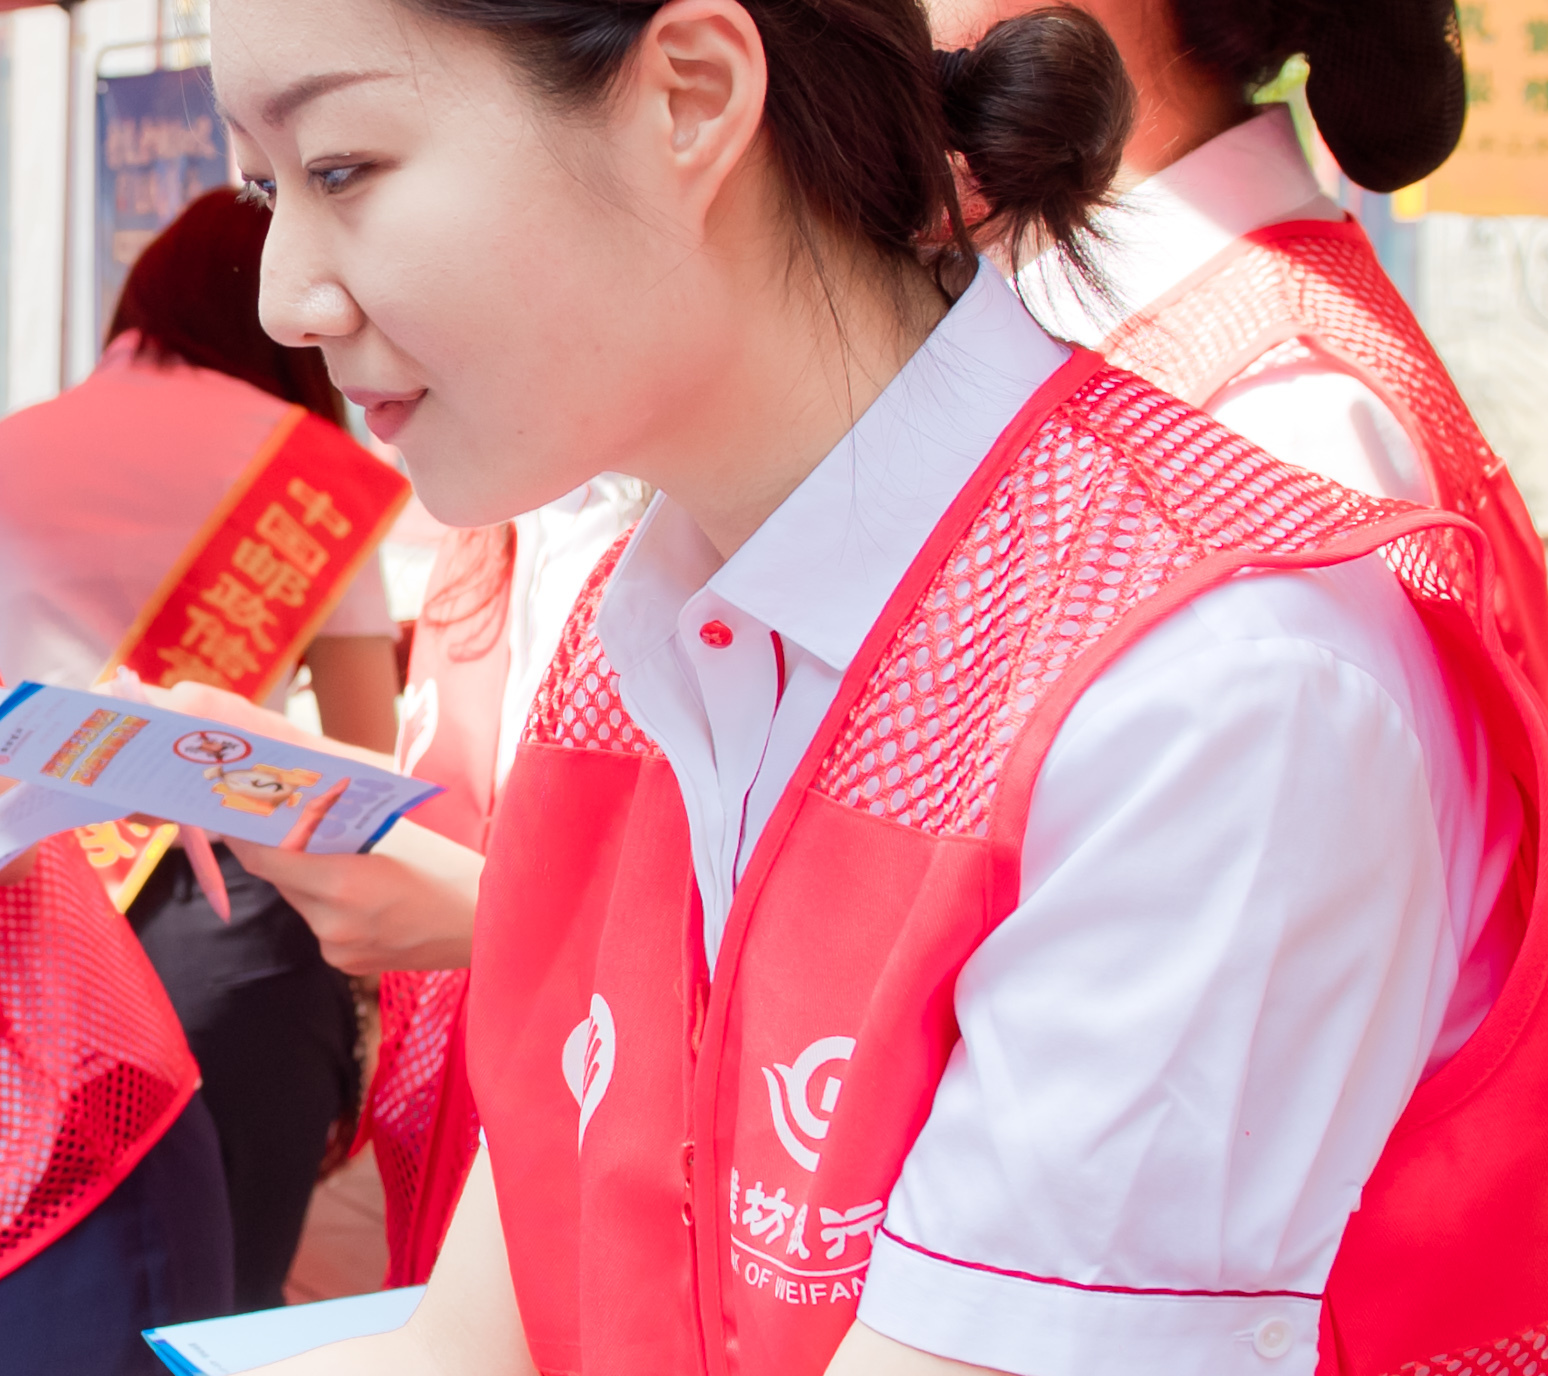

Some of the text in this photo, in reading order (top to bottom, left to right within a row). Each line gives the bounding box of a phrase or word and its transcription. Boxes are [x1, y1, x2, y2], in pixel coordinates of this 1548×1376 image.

[729, 1166, 888, 1261] 坊行
[744, 1261, 867, 1306] OF WEIFAN
